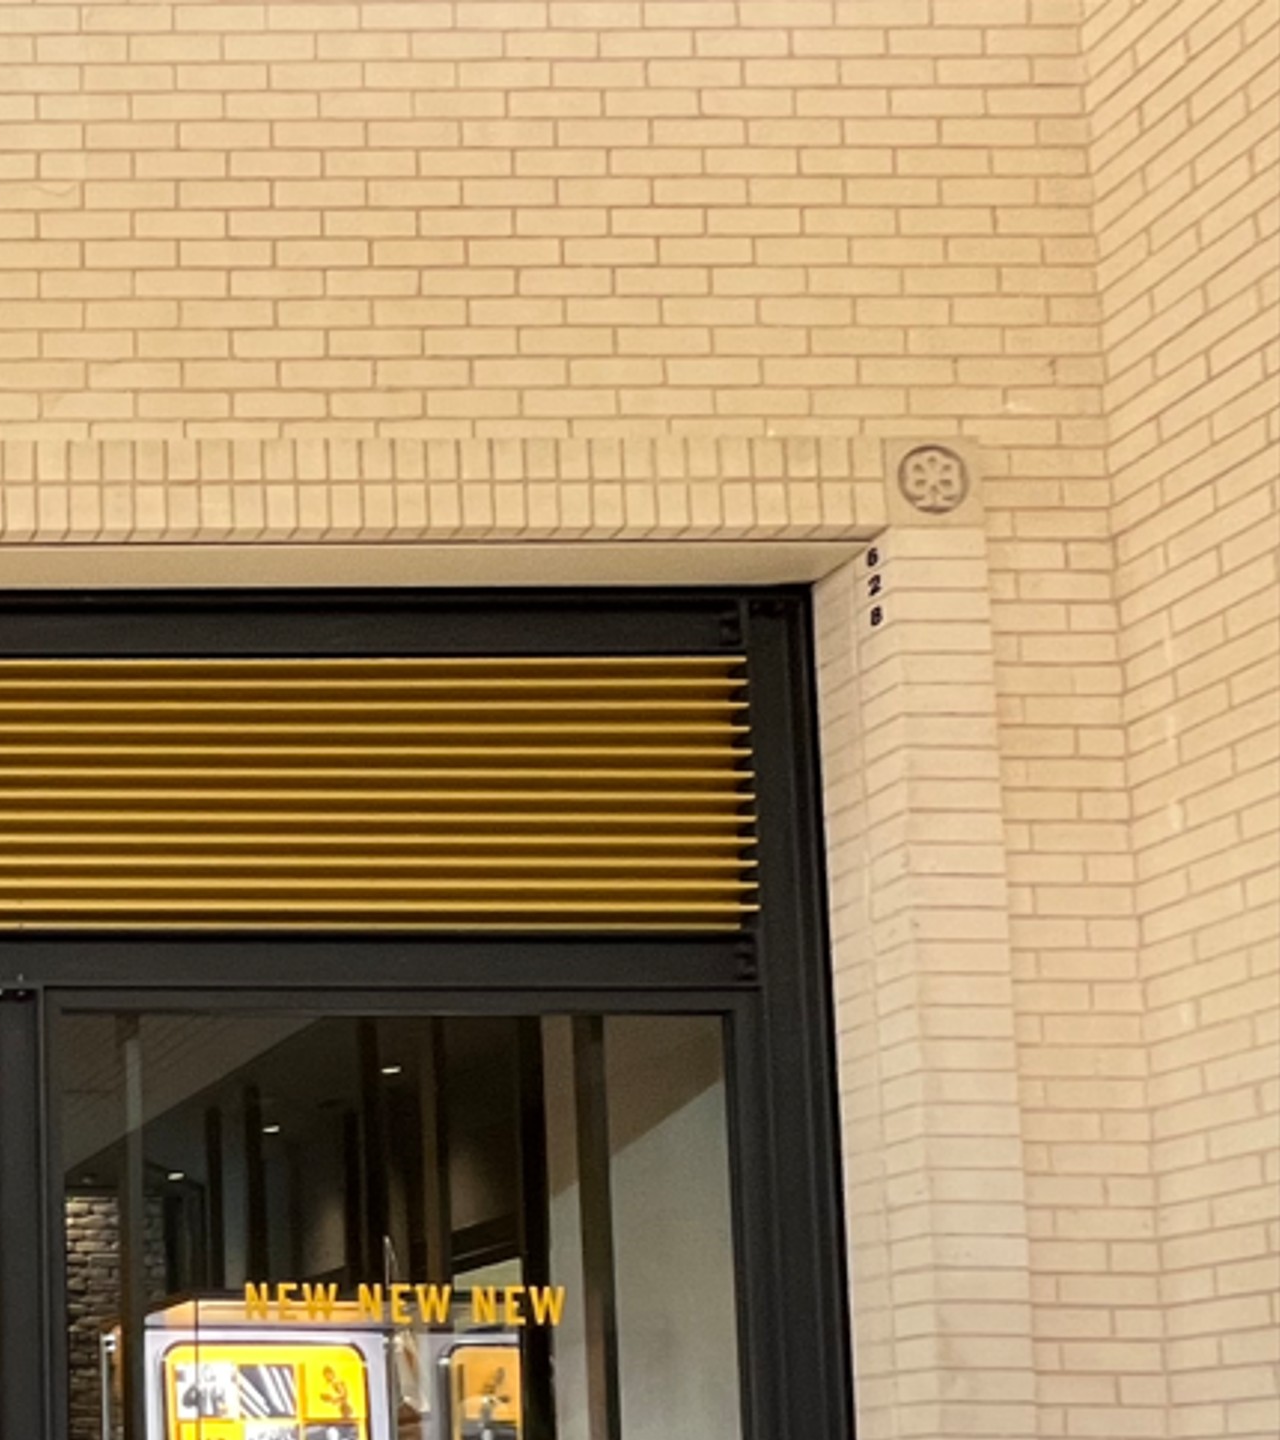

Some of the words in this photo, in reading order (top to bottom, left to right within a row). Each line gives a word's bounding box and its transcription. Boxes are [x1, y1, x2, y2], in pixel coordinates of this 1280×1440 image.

[244, 1282, 338, 1322] NEW
[357, 1282, 452, 1325] NEW
[471, 1285, 566, 1327] NEW
